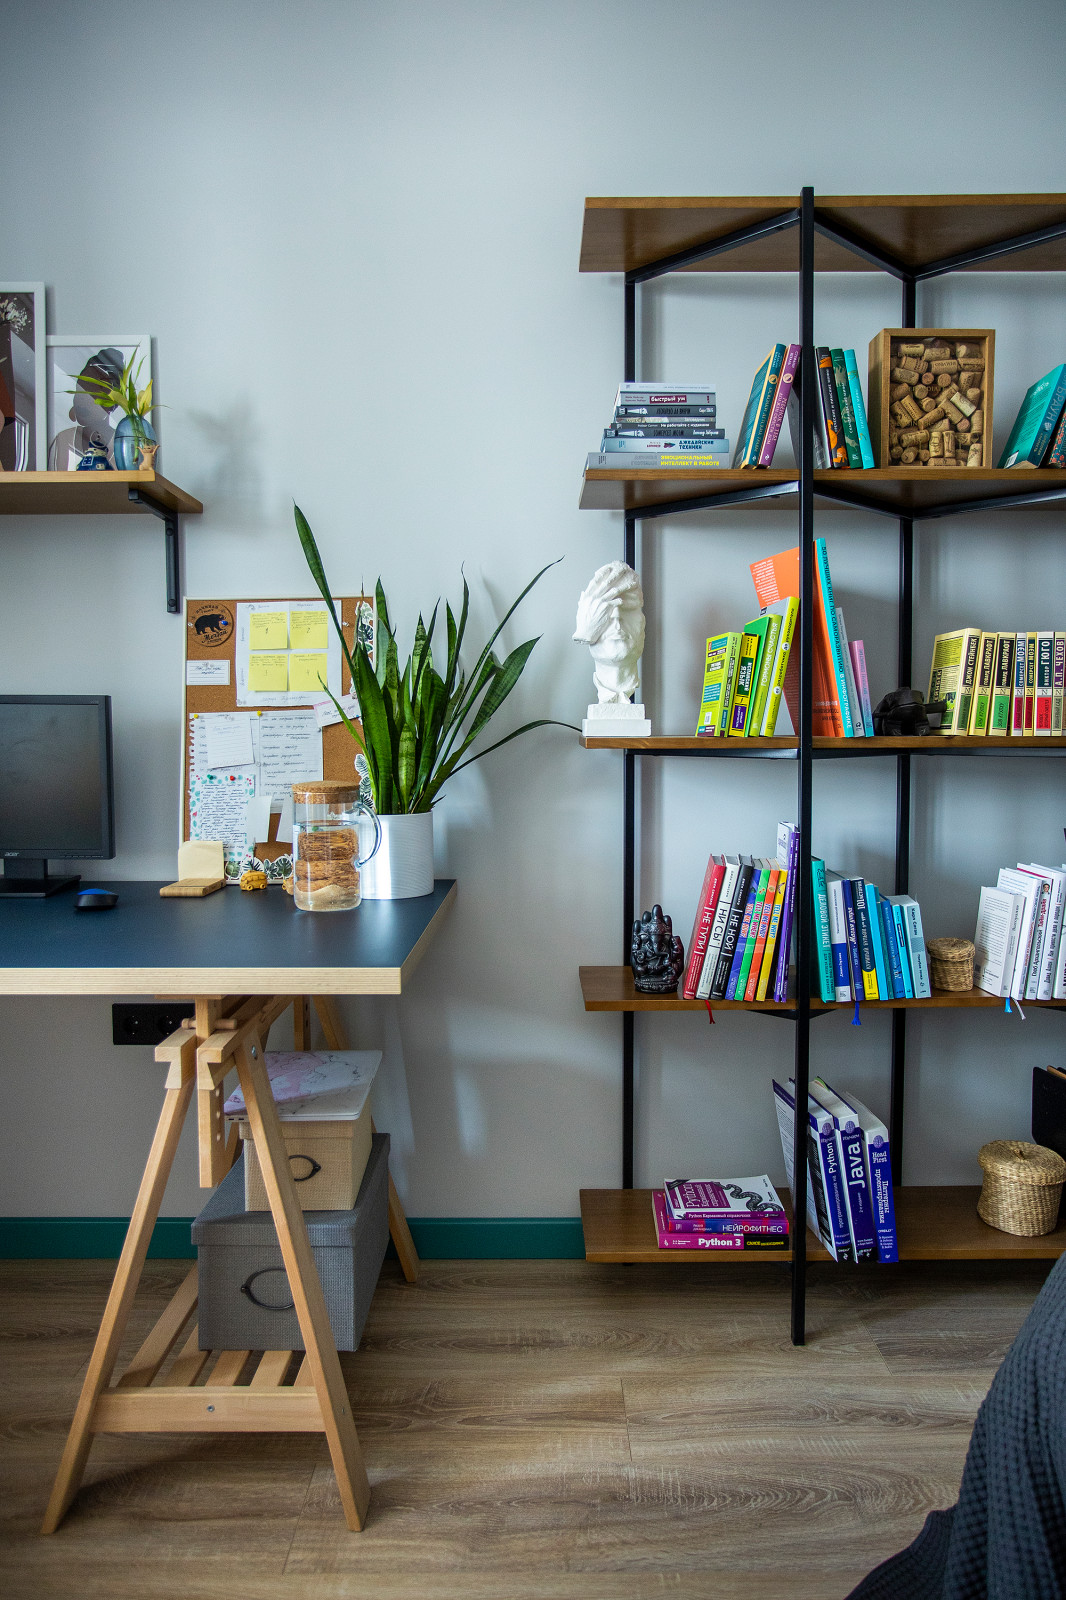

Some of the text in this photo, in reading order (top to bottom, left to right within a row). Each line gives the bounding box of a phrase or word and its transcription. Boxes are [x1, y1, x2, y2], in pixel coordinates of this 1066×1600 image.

[651, 395, 676, 403] быстрый
[1046, 386, 1064, 422] БРАУН
[821, 546, 827, 555] 50
[822, 556, 831, 585] ЛУЧШИХ
[829, 605, 835, 616] ПО
[760, 622, 778, 686] ГОРМОНЫ СЧАСТЬЯ
[776, 651, 787, 687] разработчика
[784, 607, 795, 643] руководителя
[831, 616, 843, 673] САМОРАЗВИТИЮ
[1001, 640, 1010, 670] ЛАВКРАФТ
[1040, 640, 1050, 665] ГЮГО
[738, 665, 746, 686] ЯЗЫК
[965, 666, 973, 684] ДЖОН
[1054, 640, 1064, 685] А.П. ЧЕХОВ
[840, 679, 851, 729] ИНФОГРАФИКЕ
[702, 911, 712, 924] НЕ
[743, 914, 751, 923] ME
[744, 902, 754, 915] TELL
[752, 912, 761, 921] ME
[754, 900, 763, 913] TELL
[761, 902, 771, 923] TELL ME
[856, 898, 866, 910] 101
[712, 908, 727, 941] НИ СЫ
[724, 914, 739, 950] НЕ НОЙ
[768, 903, 781, 938] TELL ME WHY?
[818, 893, 830, 948] ДЕЛОВОЙ ЭТИКЕТ
[847, 906, 857, 944] Магия утра
[1034, 929, 1042, 965] Архангельский
[1038, 897, 1047, 928] Тайм-драйв
[696, 924, 709, 950] ТУПИ
[825, 1141, 837, 1173] Python
[844, 1141, 865, 1190] Java
[833, 1181, 844, 1228] программирование
[874, 1168, 885, 1224] проектирования
[881, 1180, 891, 1213] Паттерны
[698, 1238, 733, 1248] Python
[735, 1238, 741, 1246] 3
[722, 1223, 783, 1233] НЕЙРОФИТНЕС
